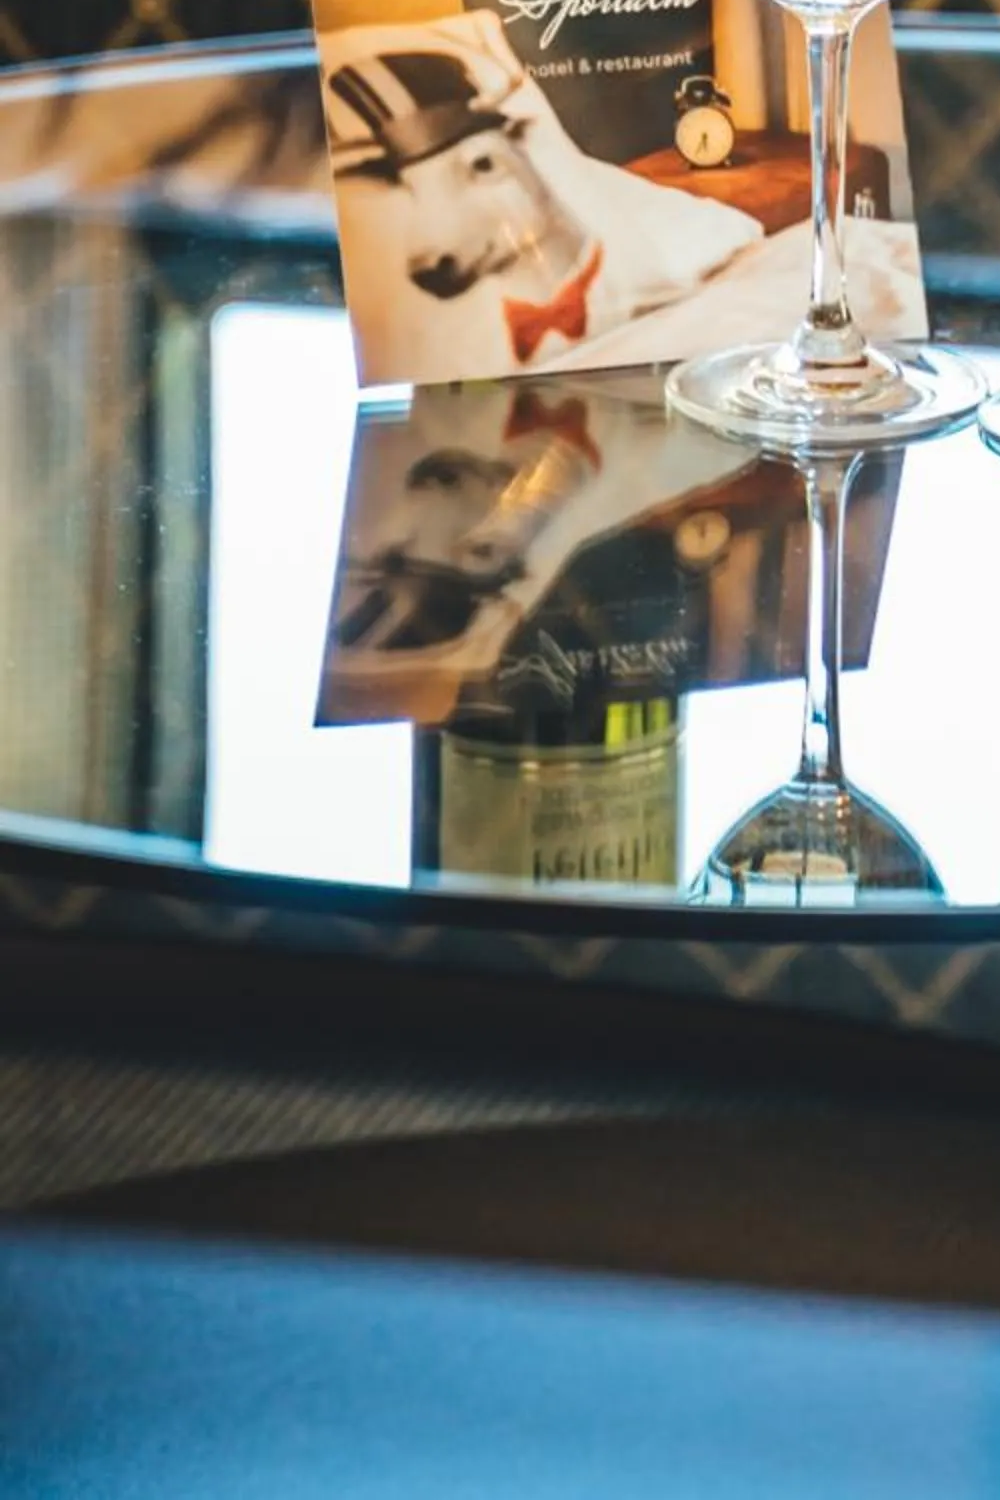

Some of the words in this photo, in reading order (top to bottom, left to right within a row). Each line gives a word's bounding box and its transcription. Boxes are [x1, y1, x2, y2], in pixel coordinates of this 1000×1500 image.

[525, 57, 573, 78] hotel
[579, 58, 591, 74] &
[596, 50, 693, 73] restaurant
